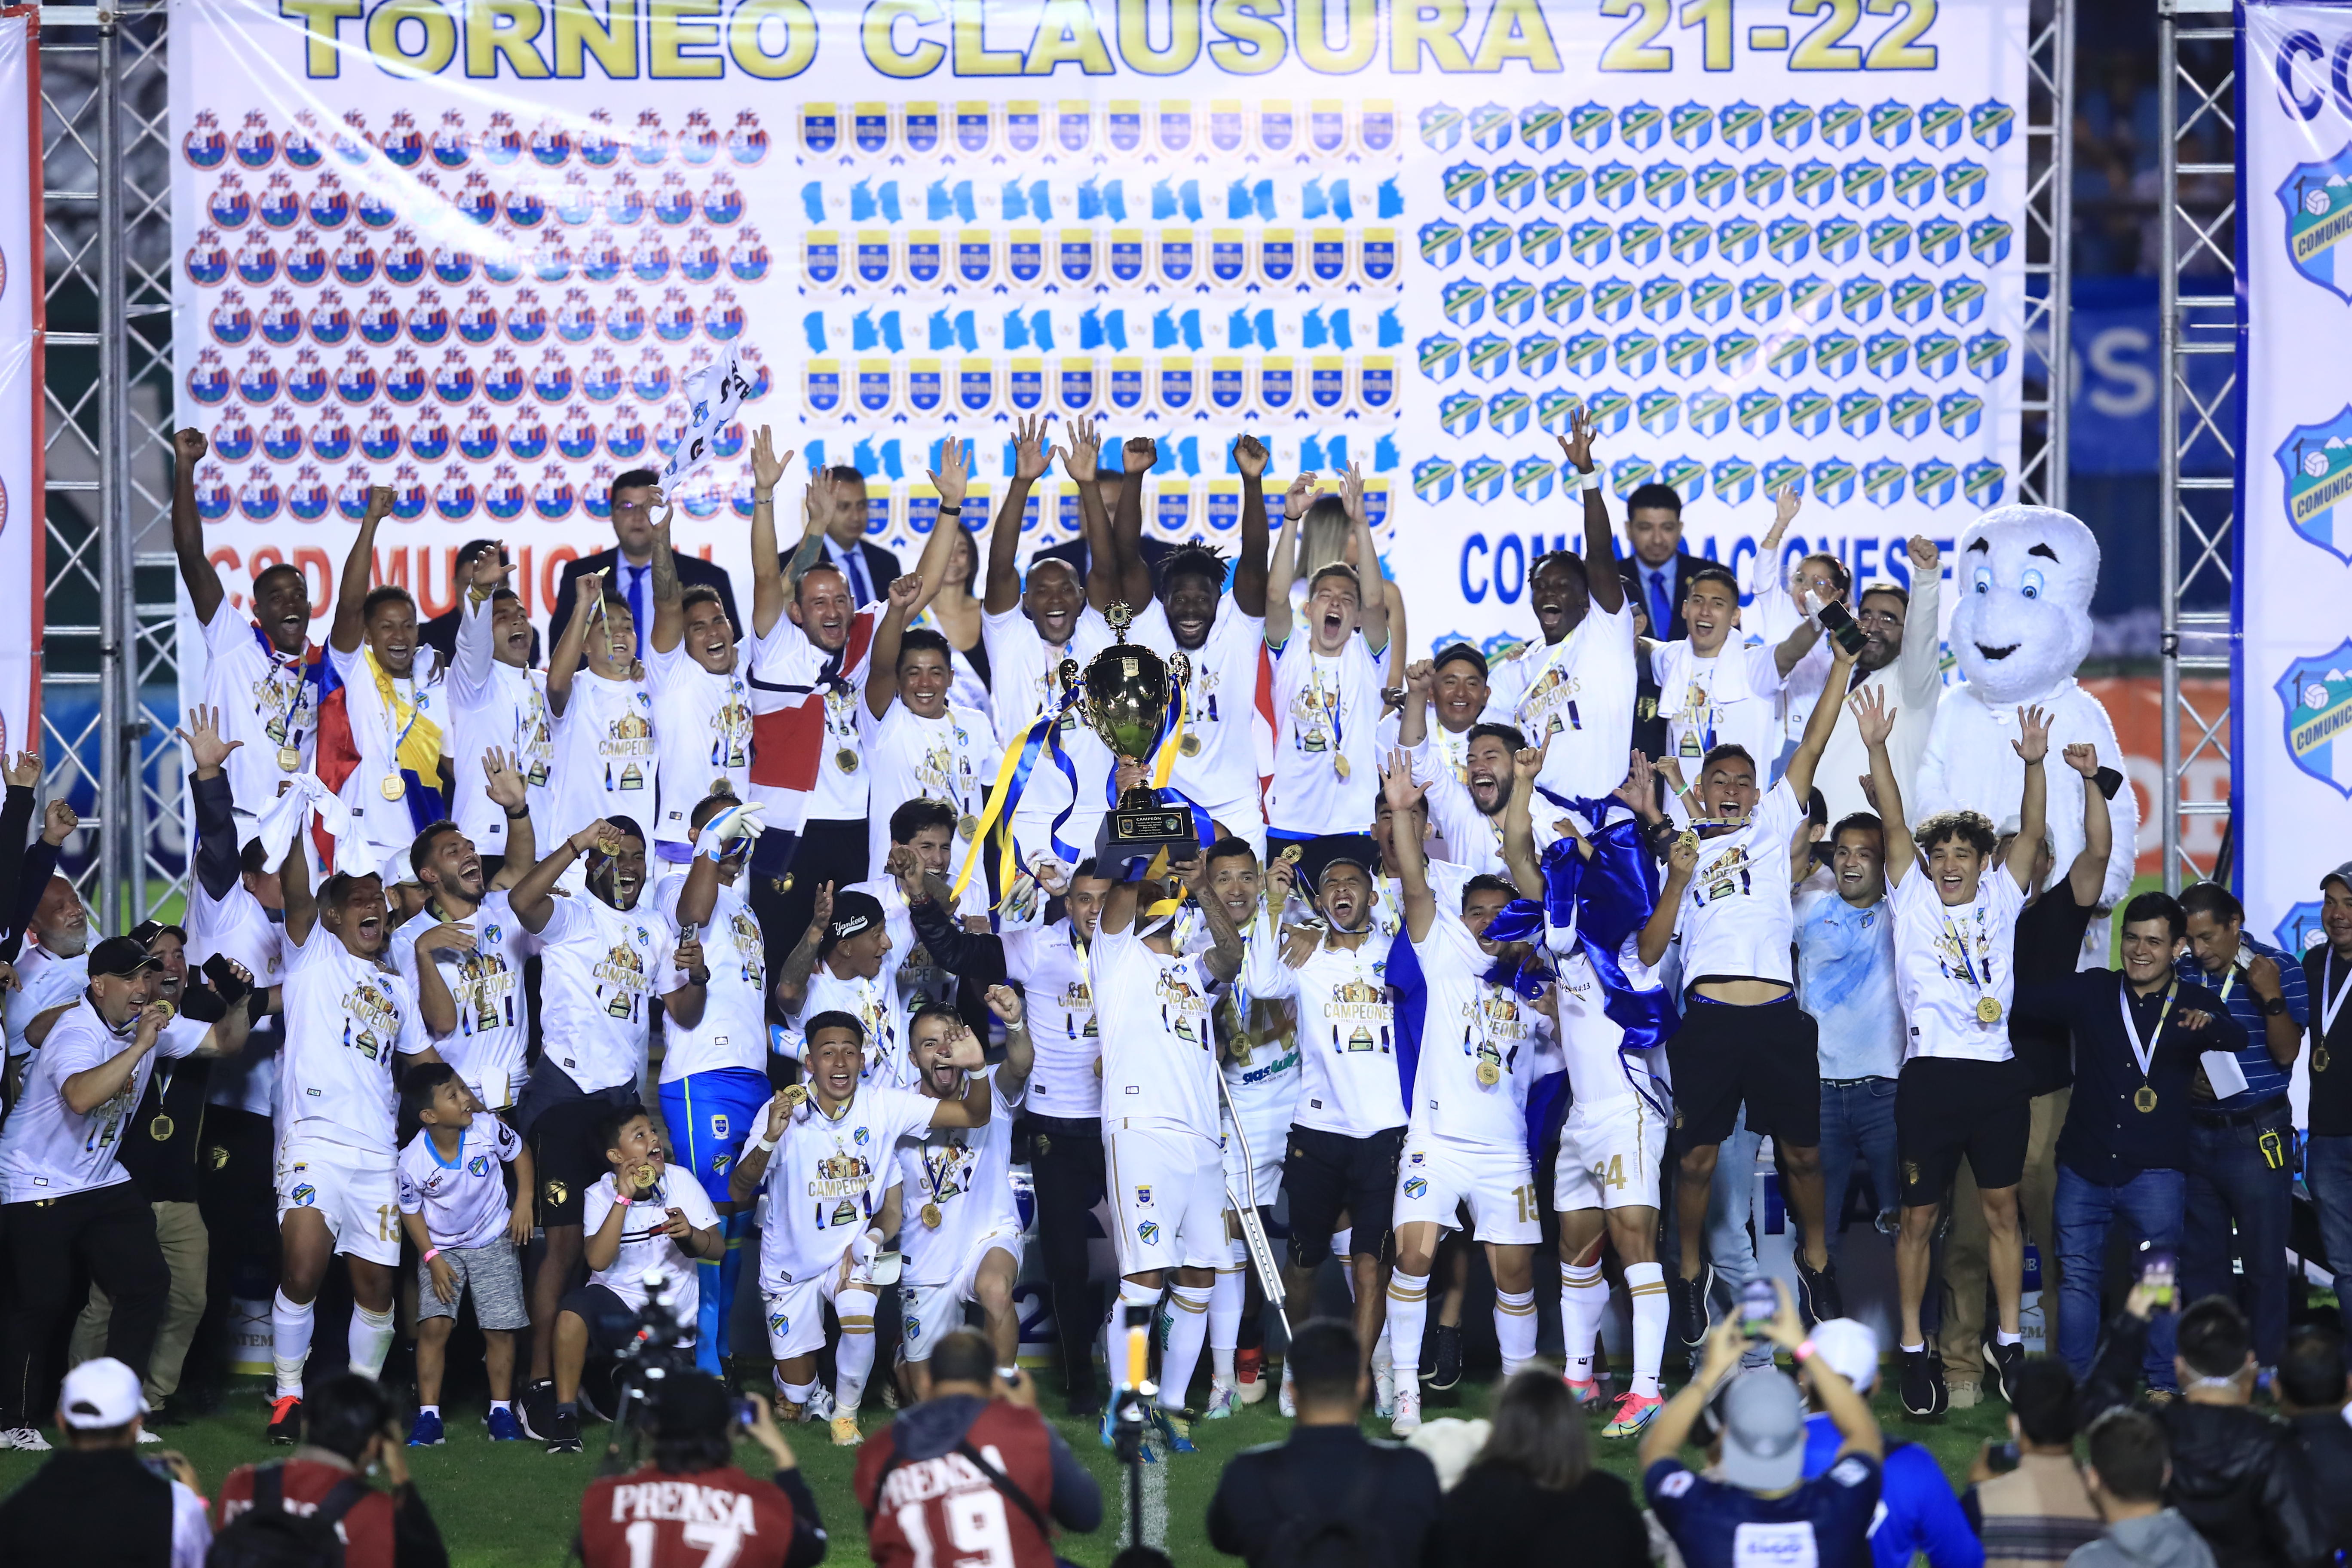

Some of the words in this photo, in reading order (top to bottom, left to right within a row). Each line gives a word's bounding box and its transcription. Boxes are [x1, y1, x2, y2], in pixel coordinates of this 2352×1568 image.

[279, 0, 819, 79] TORNEO
[860, 0, 1564, 79] CLAUSURA
[1599, 0, 1938, 72] 21-22
[625, 719, 641, 738] 31
[832, 915, 866, 936] Yankees
[1353, 986, 1370, 1002] 31
[1578, 982, 1591, 992] 4:13
[1324, 1003, 1394, 1020] CAMPEONES
[834, 1160, 852, 1178] 31
[1512, 1183, 1540, 1223] 15
[377, 1204, 402, 1243] 13
[612, 1480, 758, 1536] PRENSA
[626, 1520, 742, 1568] 17
[897, 1490, 1017, 1568] 19
